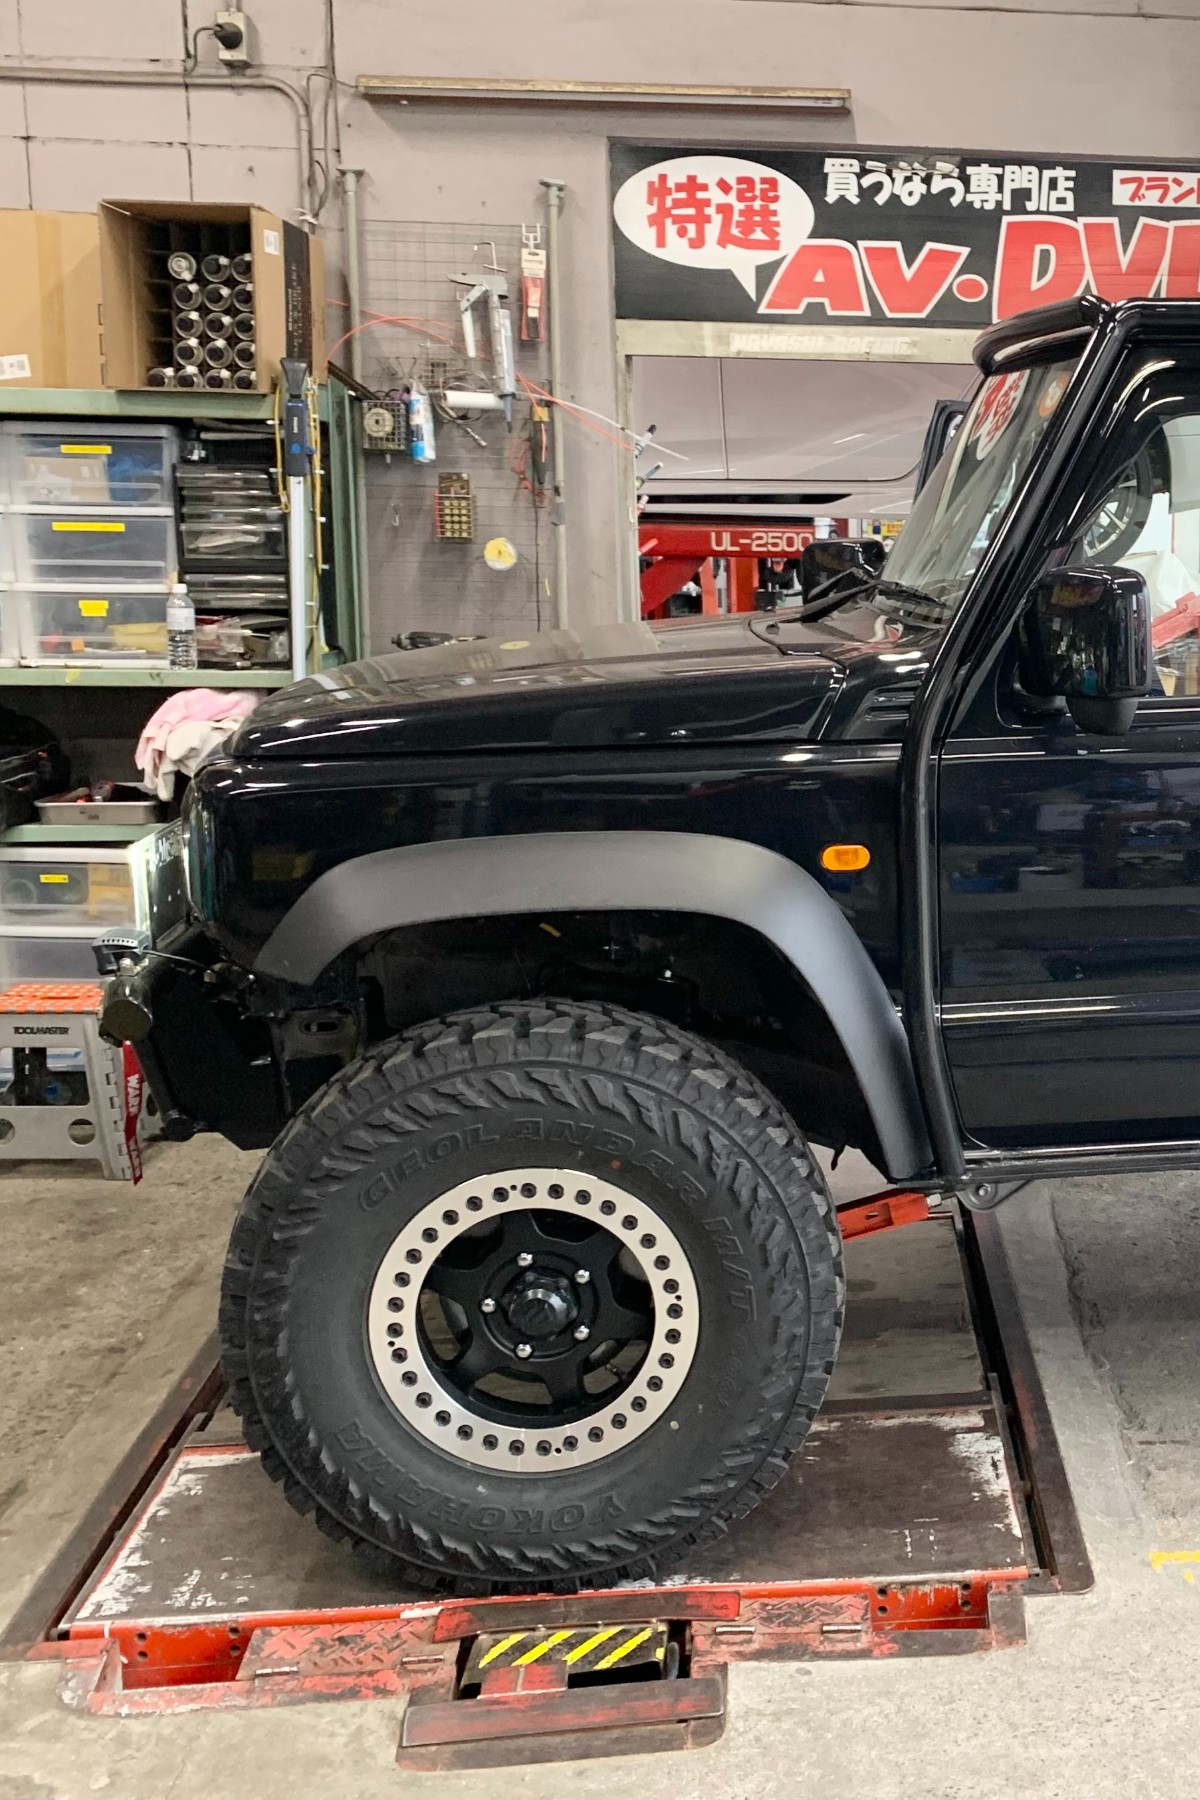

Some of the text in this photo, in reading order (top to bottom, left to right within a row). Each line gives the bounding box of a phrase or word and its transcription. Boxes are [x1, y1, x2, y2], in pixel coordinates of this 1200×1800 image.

[647, 174, 782, 251] 特選
[824, 158, 1075, 212] 買うなら専門店
[710, 531, 813, 552] UL-2500
[12, 1026, 70, 1035] TOOLMASTER
[359, 1117, 757, 1322] GEOLANDAR M/T
[332, 1418, 627, 1535] YOKOHAMA
